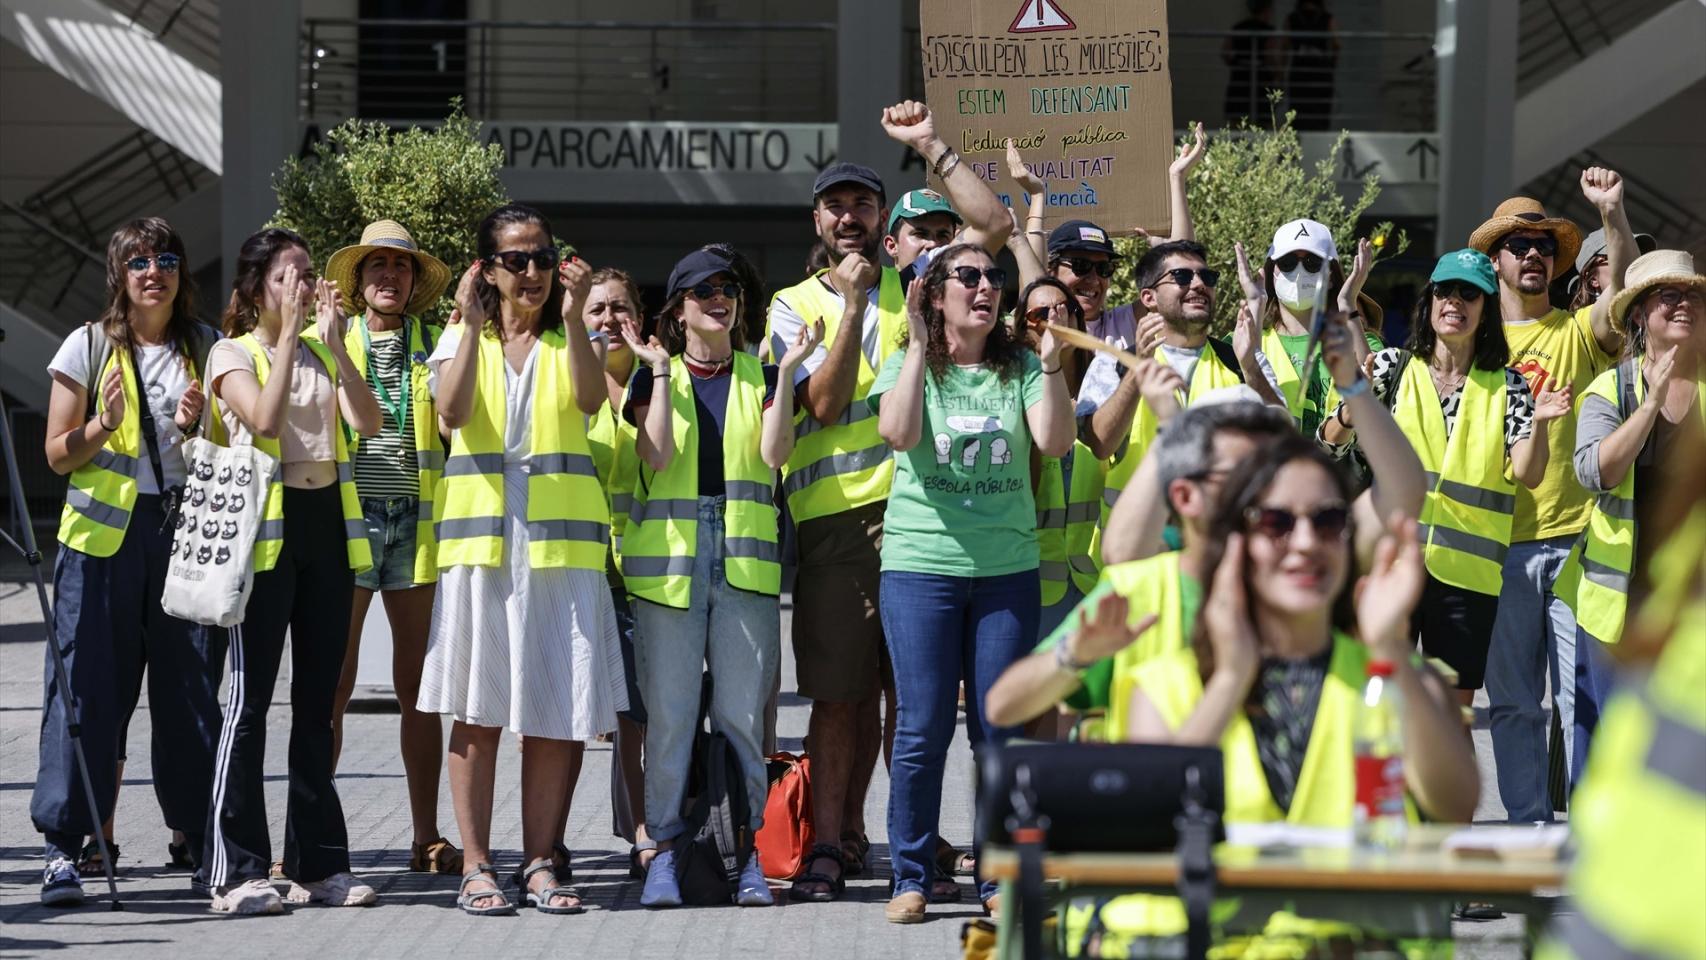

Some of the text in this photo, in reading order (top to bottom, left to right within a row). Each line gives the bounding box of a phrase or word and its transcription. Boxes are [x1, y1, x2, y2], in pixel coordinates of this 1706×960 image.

[934, 40, 1156, 74] DISCULPEN LES MOLESTIES
[958, 85, 1131, 115] ESTEM DEFENSANT
[485, 126, 790, 170] APARCAMIENTO
[1060, 125, 1127, 157] pública
[972, 162, 997, 180] DE
[935, 395, 1016, 412] ESTIMEM
